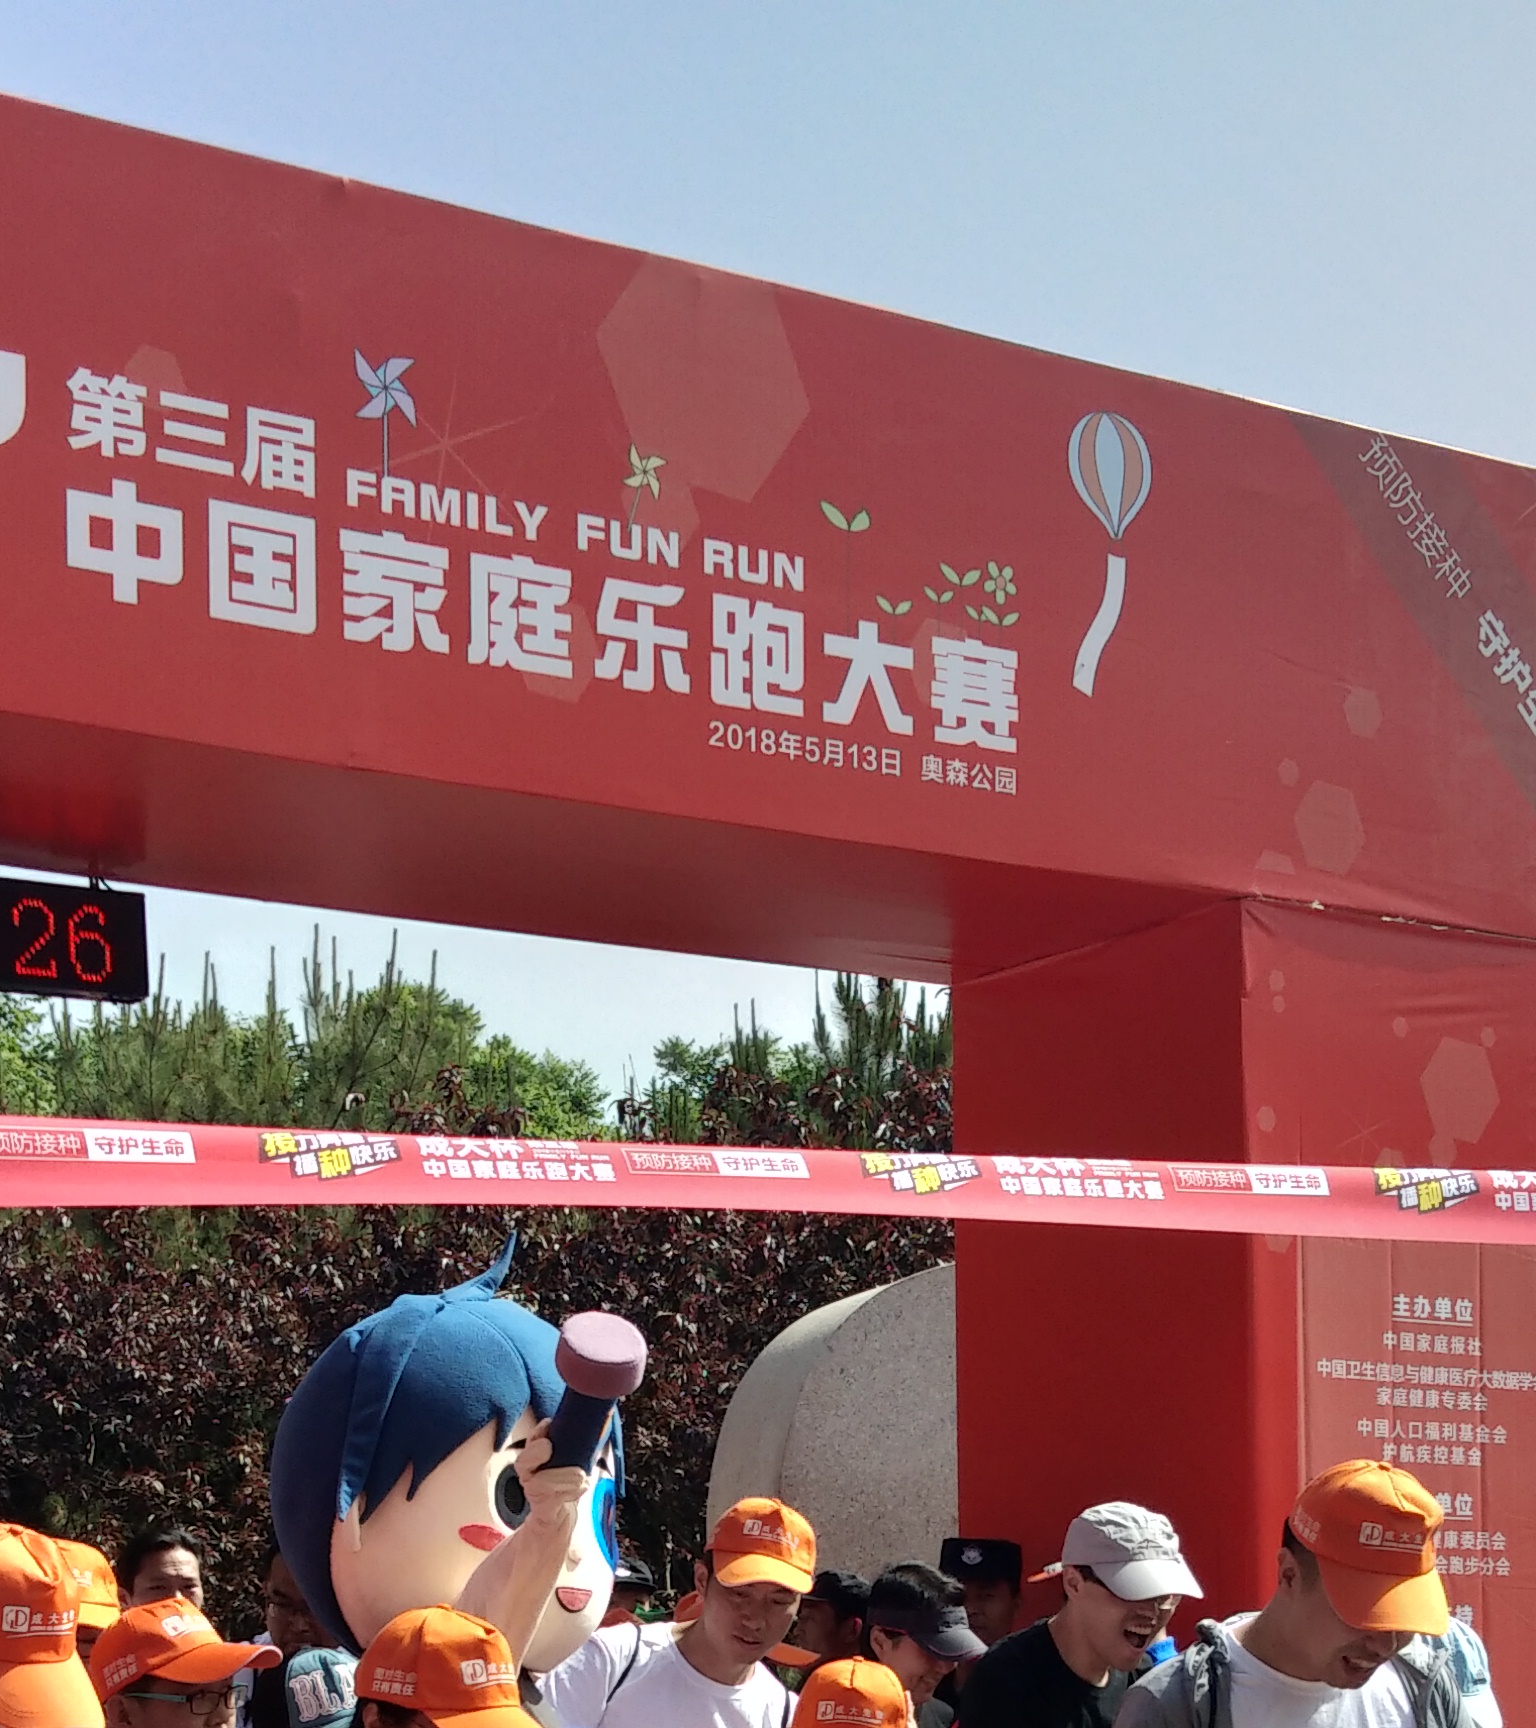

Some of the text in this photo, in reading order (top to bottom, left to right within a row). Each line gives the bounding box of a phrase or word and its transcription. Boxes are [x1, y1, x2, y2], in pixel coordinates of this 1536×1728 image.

[66, 367, 316, 498] 第三届
[345, 466, 804, 592] FAMILY FUN RUN
[1358, 433, 1472, 600] 预防接种
[66, 479, 1018, 753] 中国家庭乐跑大赛
[708, 719, 1017, 796] 2018年5月13日 奥森公园
[93, 1134, 184, 1158] 守护生命
[293, 1142, 397, 1179] 播种快乐
[630, 1151, 800, 1177] 预防接种 守护生命
[1392, 1293, 1474, 1321] 主办单位
[1382, 1330, 1483, 1357] 中国家庭报社
[1376, 1387, 1488, 1412] 家庭健康专委会
[1357, 1417, 1507, 1445] 中国人口福利基金会
[1382, 1443, 1482, 1467] 护航疾控基金
